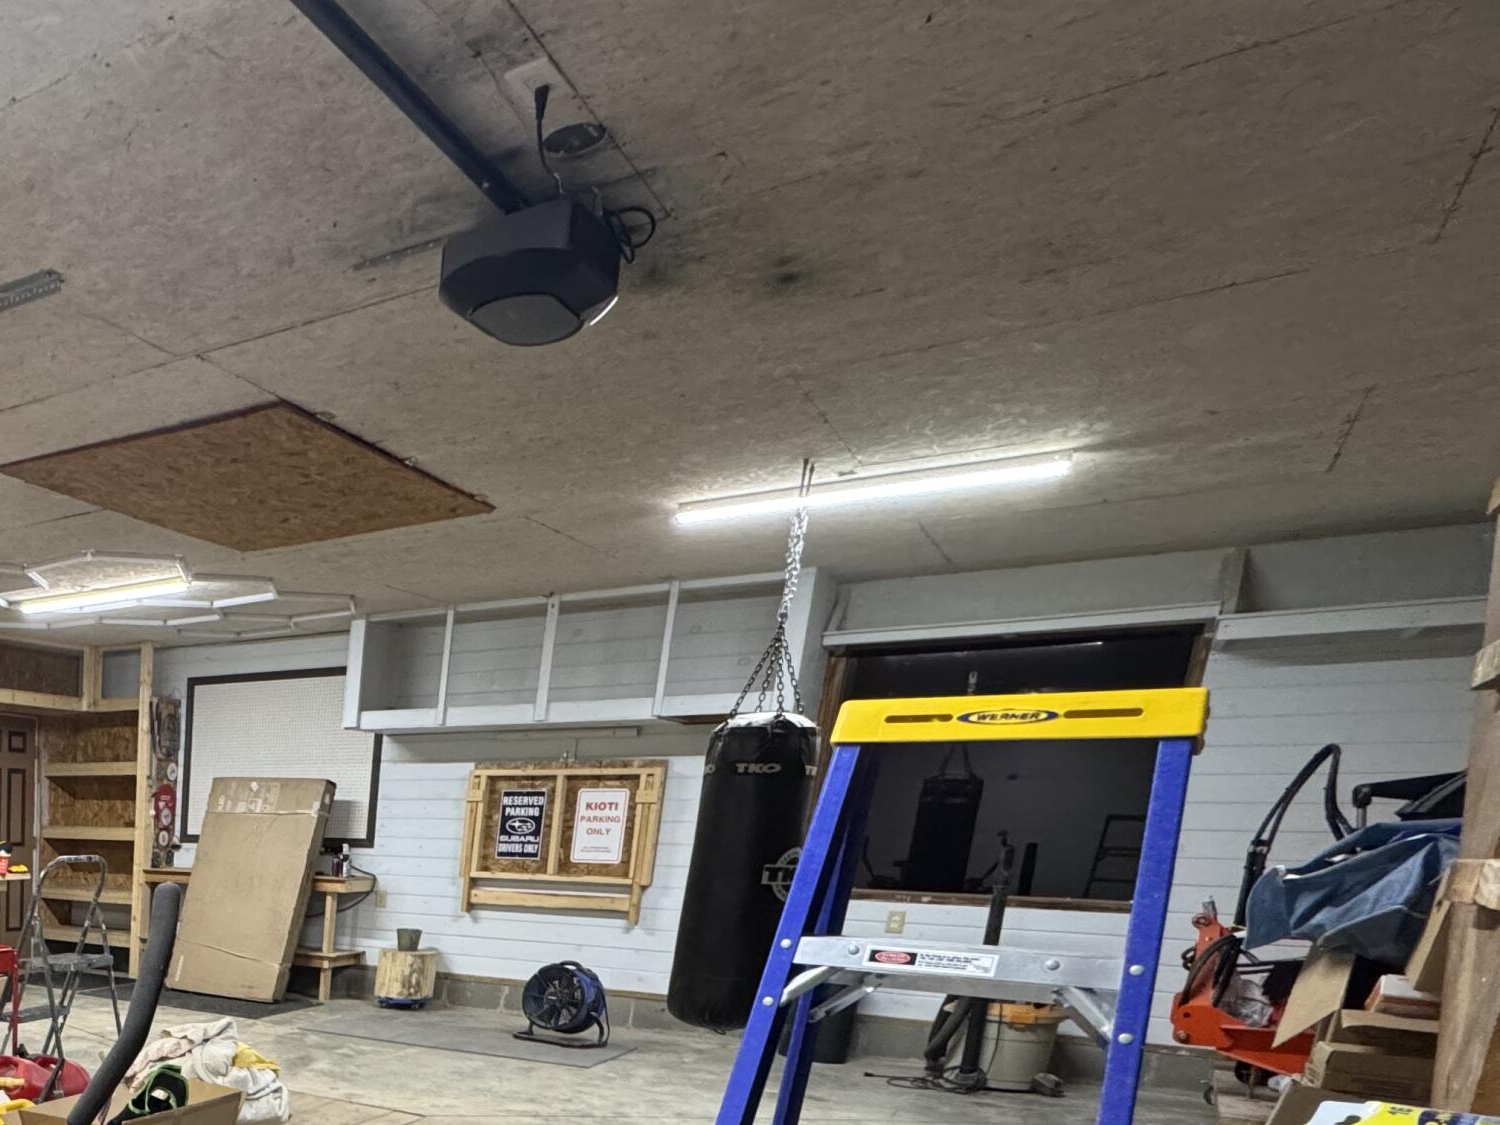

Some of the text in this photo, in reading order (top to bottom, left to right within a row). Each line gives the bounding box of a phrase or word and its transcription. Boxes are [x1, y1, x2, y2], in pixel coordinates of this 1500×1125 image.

[976, 711, 1042, 722] WERNER
[735, 762, 782, 775] TKO
[503, 795, 545, 806] RESERVED
[585, 802, 619, 811] KIOTI
[504, 807, 540, 817] PARKING
[579, 815, 621, 824] PARKING
[586, 827, 612, 836] ONLY
[499, 834, 540, 842] SUBARU
[498, 843, 539, 854] DRIVERS ONLY
